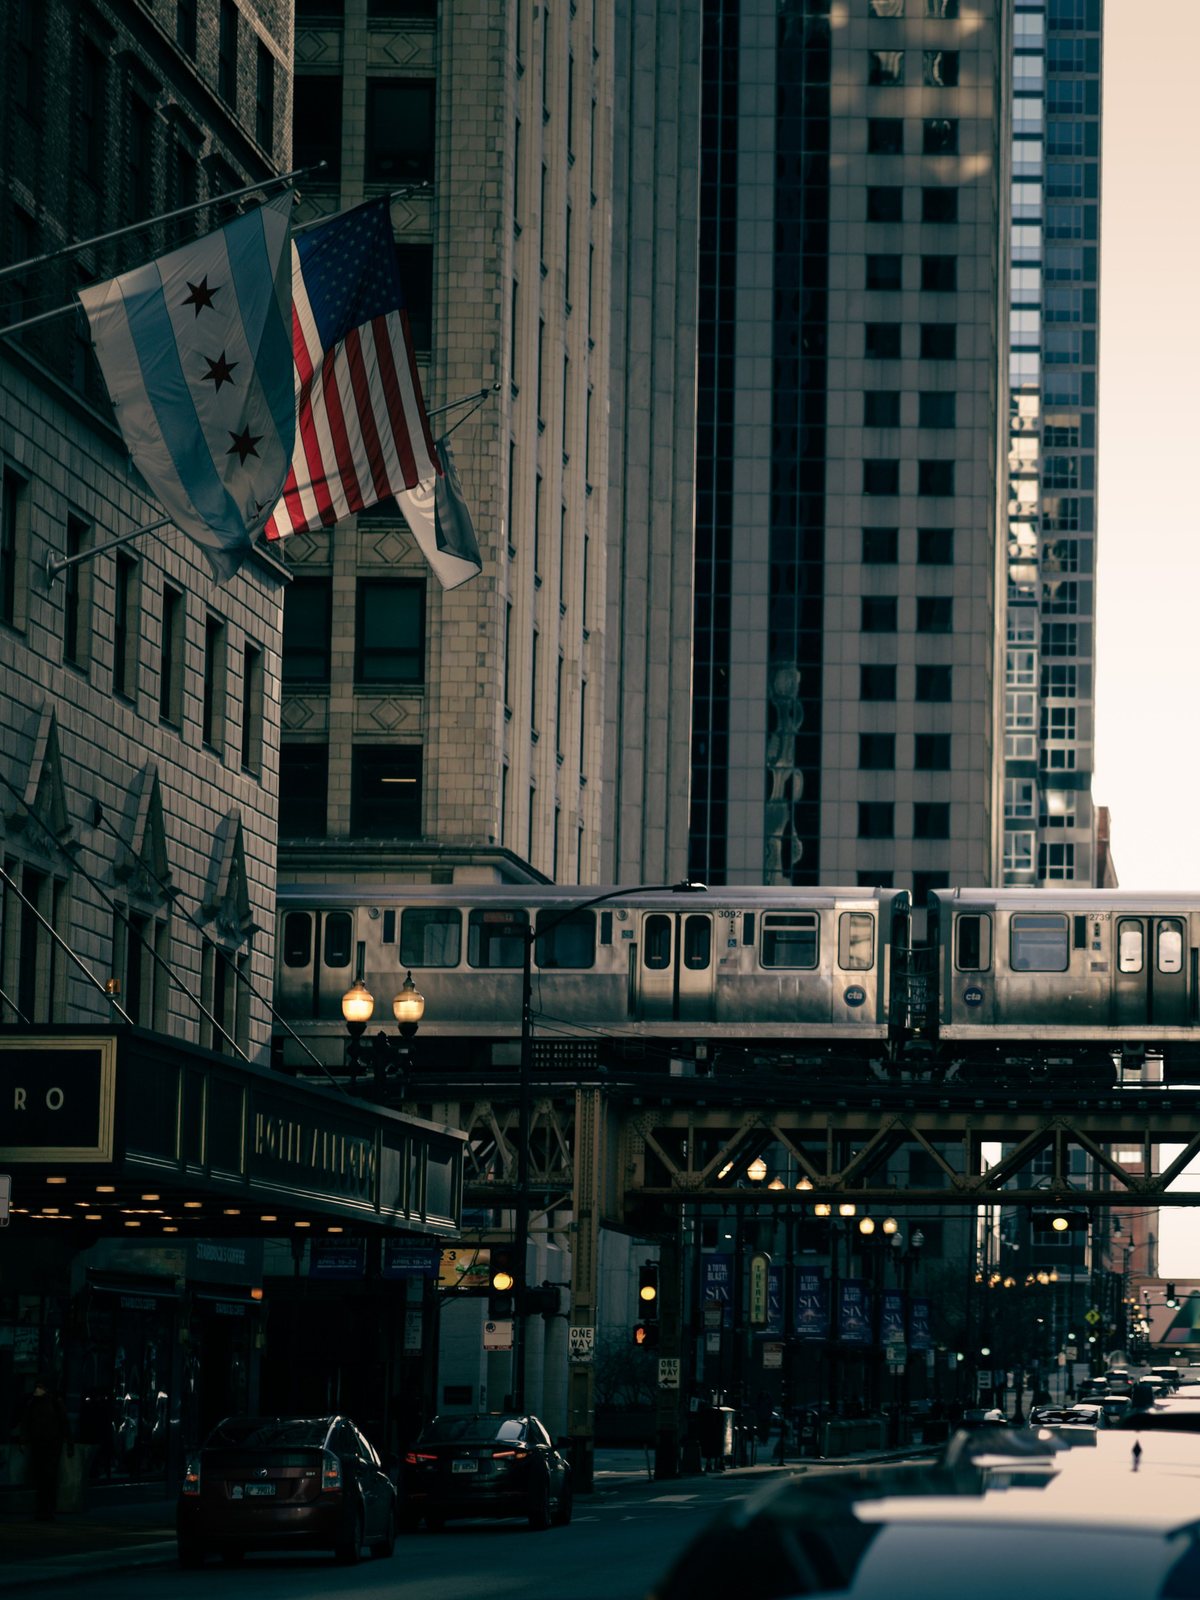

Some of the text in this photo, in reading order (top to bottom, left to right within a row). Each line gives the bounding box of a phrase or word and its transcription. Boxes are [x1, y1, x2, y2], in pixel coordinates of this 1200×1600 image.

[718, 910, 742, 919] 3092
[1089, 913, 1111, 921] 2739
[846, 992, 863, 1000] cta
[965, 993, 982, 1001] cta
[449, 1250, 456, 1261] 3
[706, 1286, 729, 1301] SIX
[571, 1329, 592, 1338] ONE
[571, 1339, 592, 1348] WAY
[660, 1360, 678, 1368] ONE
[660, 1368, 678, 1376] WAY
